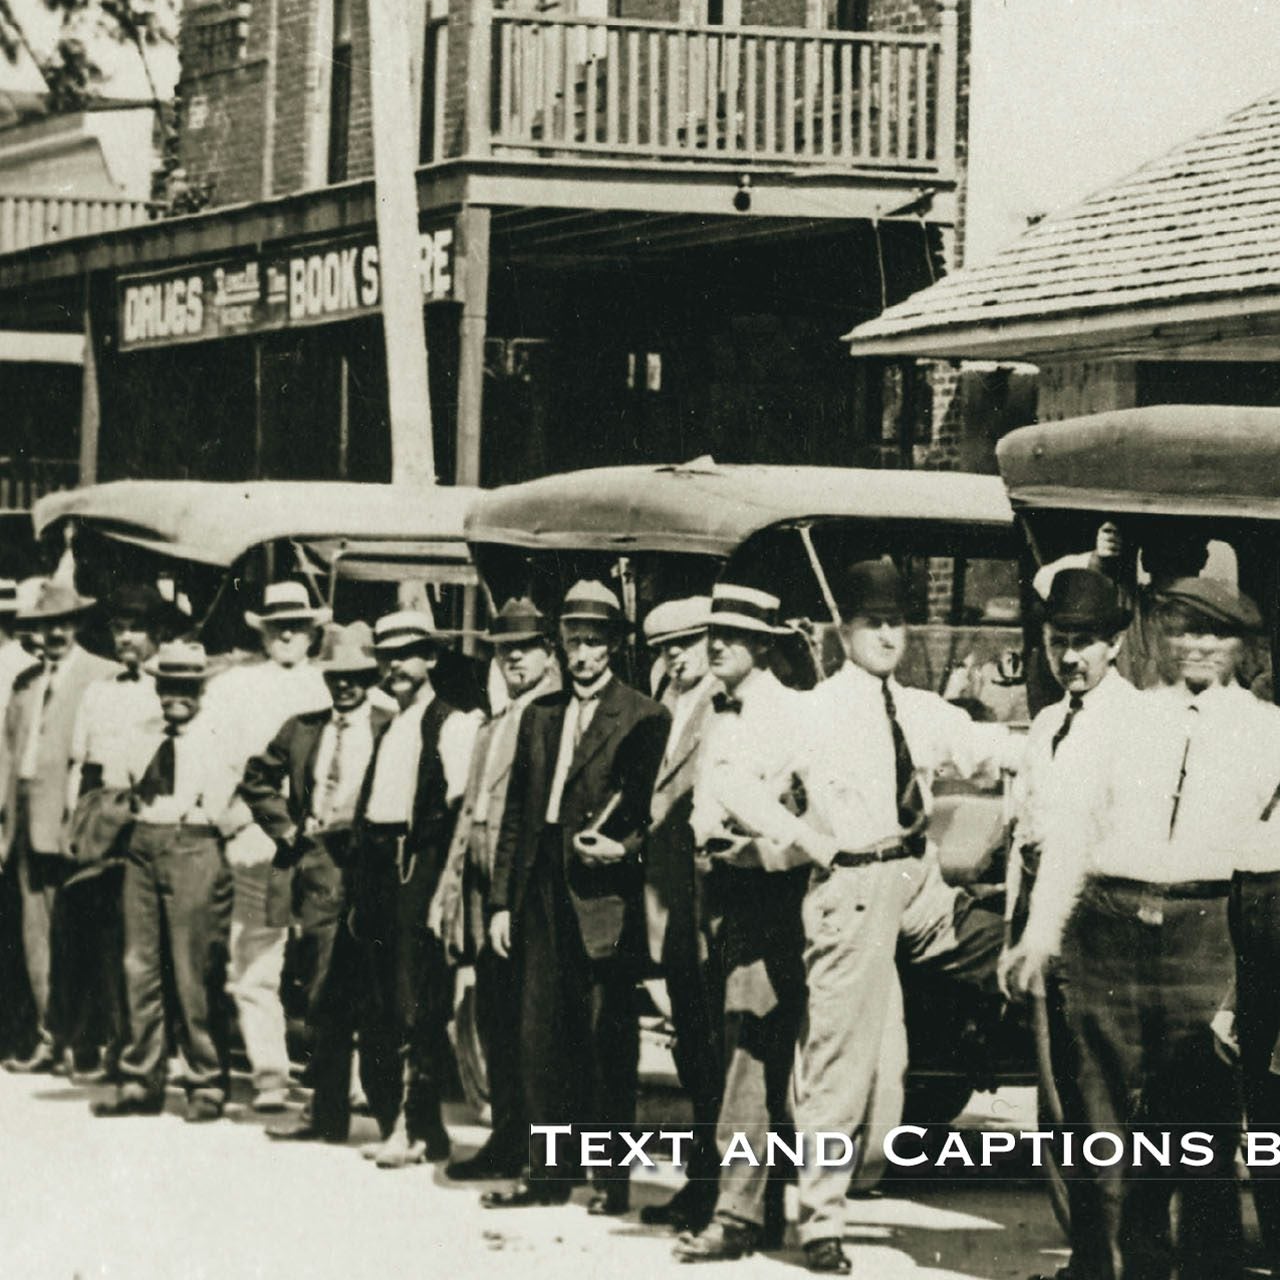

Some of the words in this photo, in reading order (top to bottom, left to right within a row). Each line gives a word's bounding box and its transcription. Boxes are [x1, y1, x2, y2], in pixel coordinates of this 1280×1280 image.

[124, 275, 204, 342] DRUGS
[289, 249, 358, 319] BOOK
[362, 229, 453, 306] SRE
